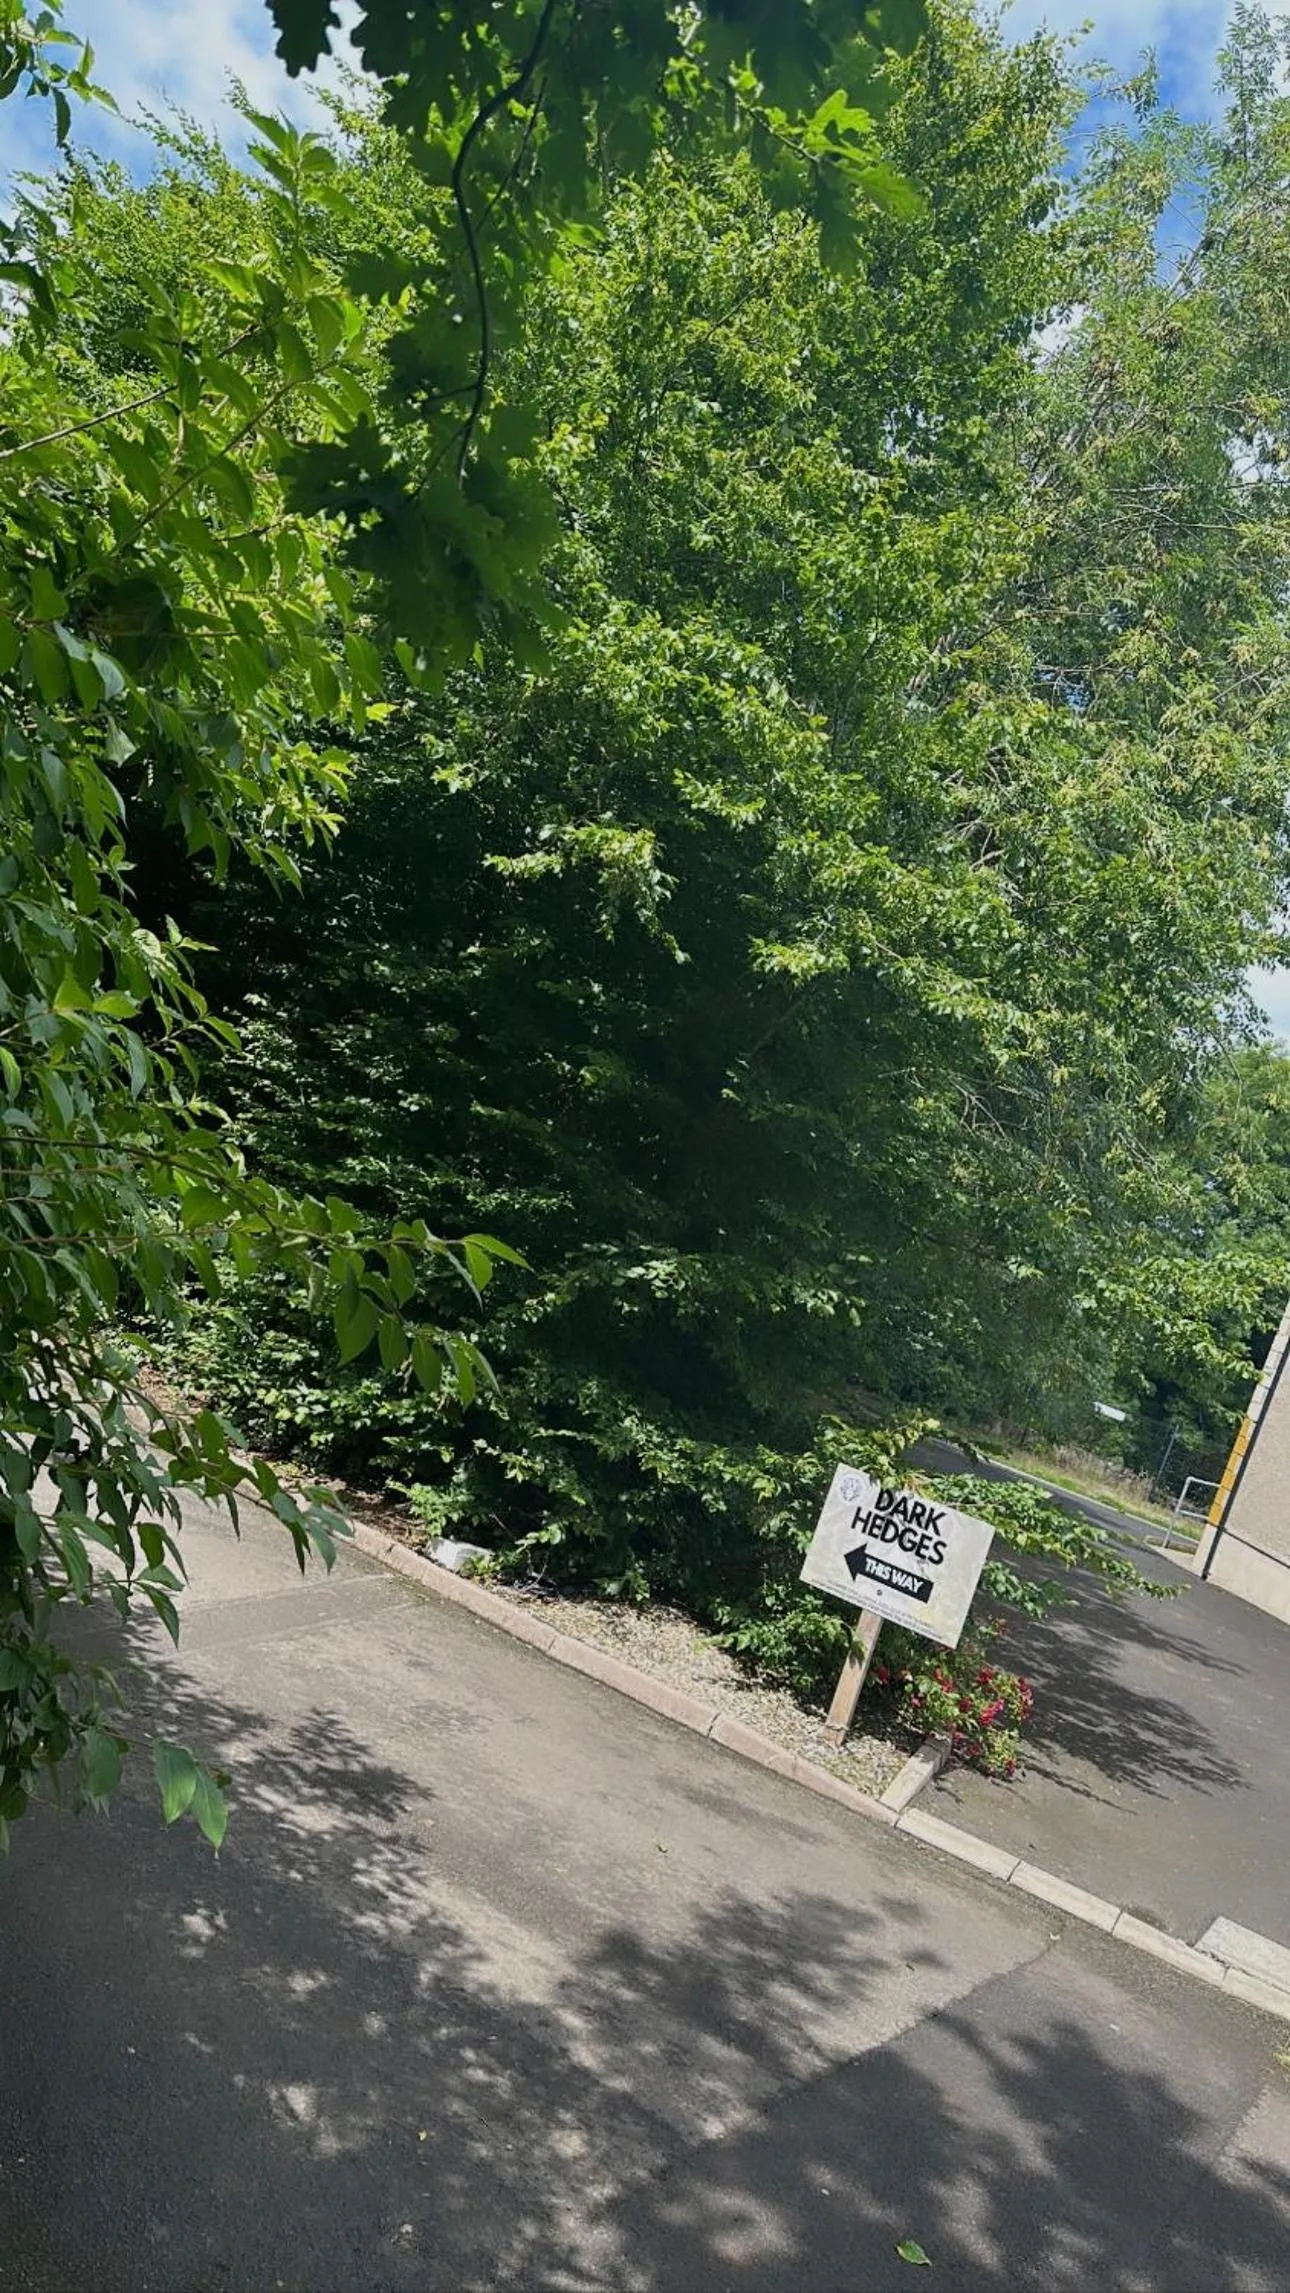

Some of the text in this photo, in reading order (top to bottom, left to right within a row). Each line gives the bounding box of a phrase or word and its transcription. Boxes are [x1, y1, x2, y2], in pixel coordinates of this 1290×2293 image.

[851, 1506, 947, 1565] HEDGES
[874, 1488, 947, 1536] DARK
[865, 1559, 924, 1593] THIS WAY
